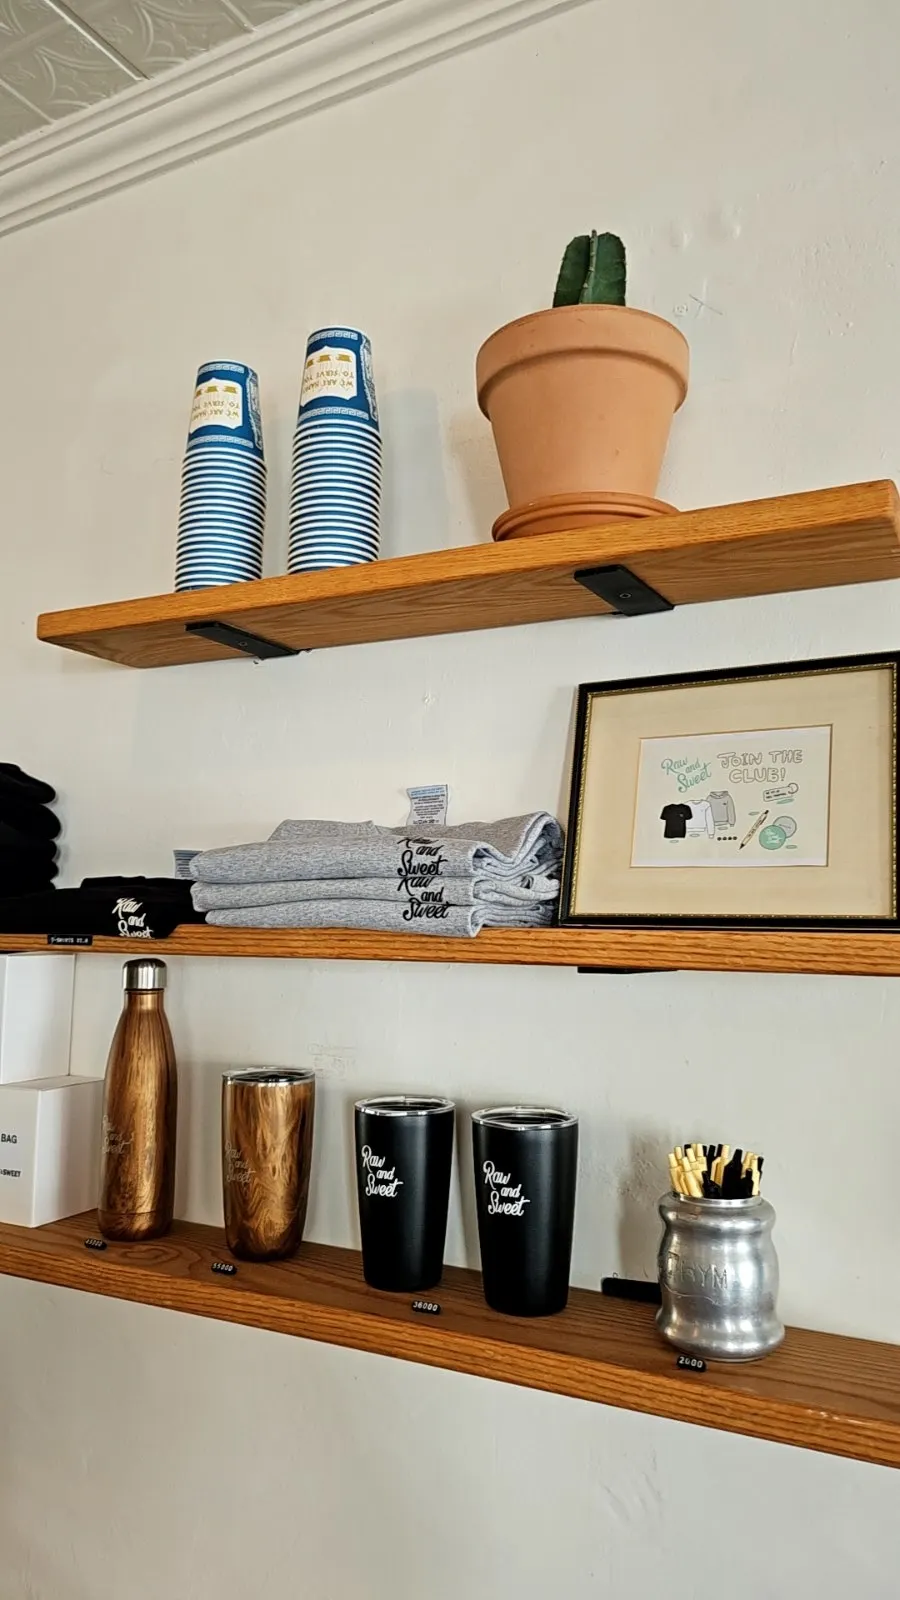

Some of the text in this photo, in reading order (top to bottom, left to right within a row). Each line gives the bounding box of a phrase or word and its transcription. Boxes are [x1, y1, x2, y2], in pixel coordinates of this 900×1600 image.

[661, 757, 688, 775] Raw
[685, 758, 702, 774] and
[716, 749, 803, 769] JOIN THE
[677, 762, 711, 793] Sweet
[729, 767, 786, 784] CLUB!
[416, 845, 445, 857] and
[397, 850, 448, 876] Sweet
[421, 887, 444, 902] and
[403, 897, 457, 921] Sweet
[127, 913, 146, 927] and
[1, 1133, 18, 1144] BAG
[361, 1145, 386, 1174] Raw
[376, 1167, 395, 1181] and
[483, 1160, 511, 1190] Raw
[365, 1173, 404, 1198] Sweet
[500, 1184, 522, 1198] and
[488, 1190, 531, 1216] Sweet
[413, 1301, 438, 1312] 36000
[679, 1356, 704, 1368] 2000
